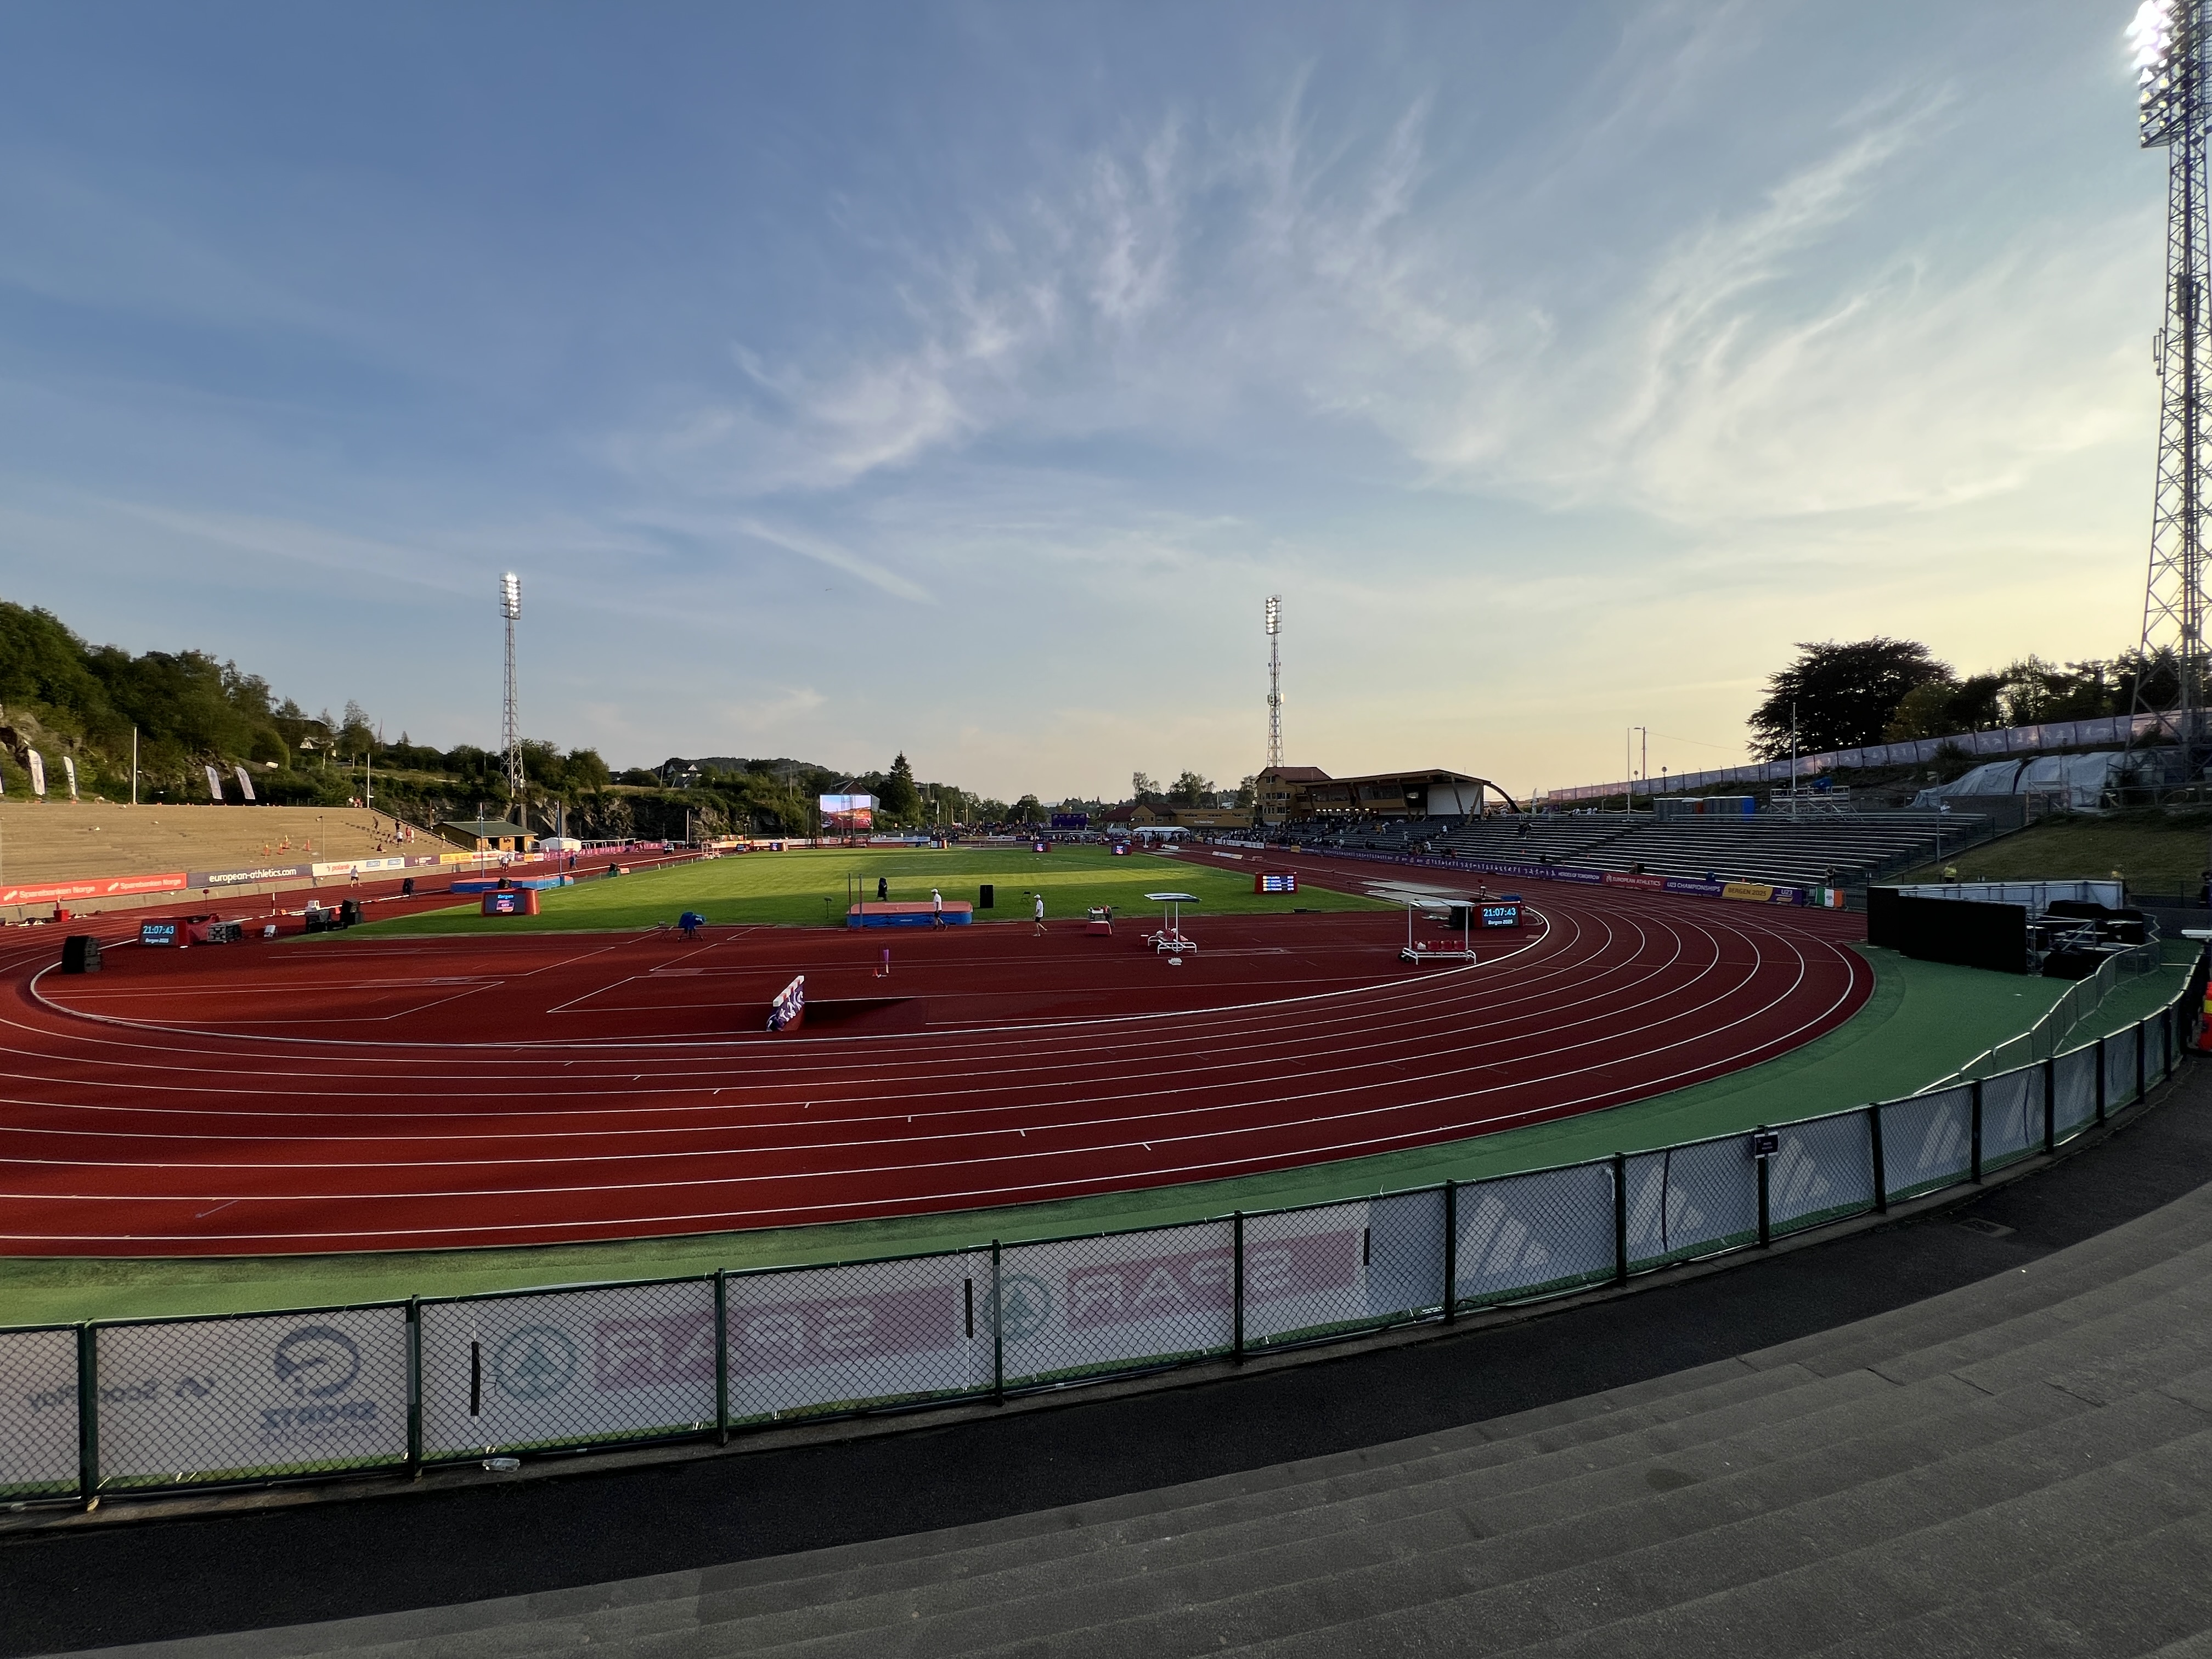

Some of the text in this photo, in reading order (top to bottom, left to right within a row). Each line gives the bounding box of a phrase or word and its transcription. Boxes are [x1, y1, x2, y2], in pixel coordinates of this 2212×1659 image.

[209, 868, 297, 883] european-athletics.com
[1677, 882, 1721, 892] CHAMPIONSHIPS
[1483, 907, 1516, 917] 21:07:43
[143, 926, 174, 934] 21:07:43
